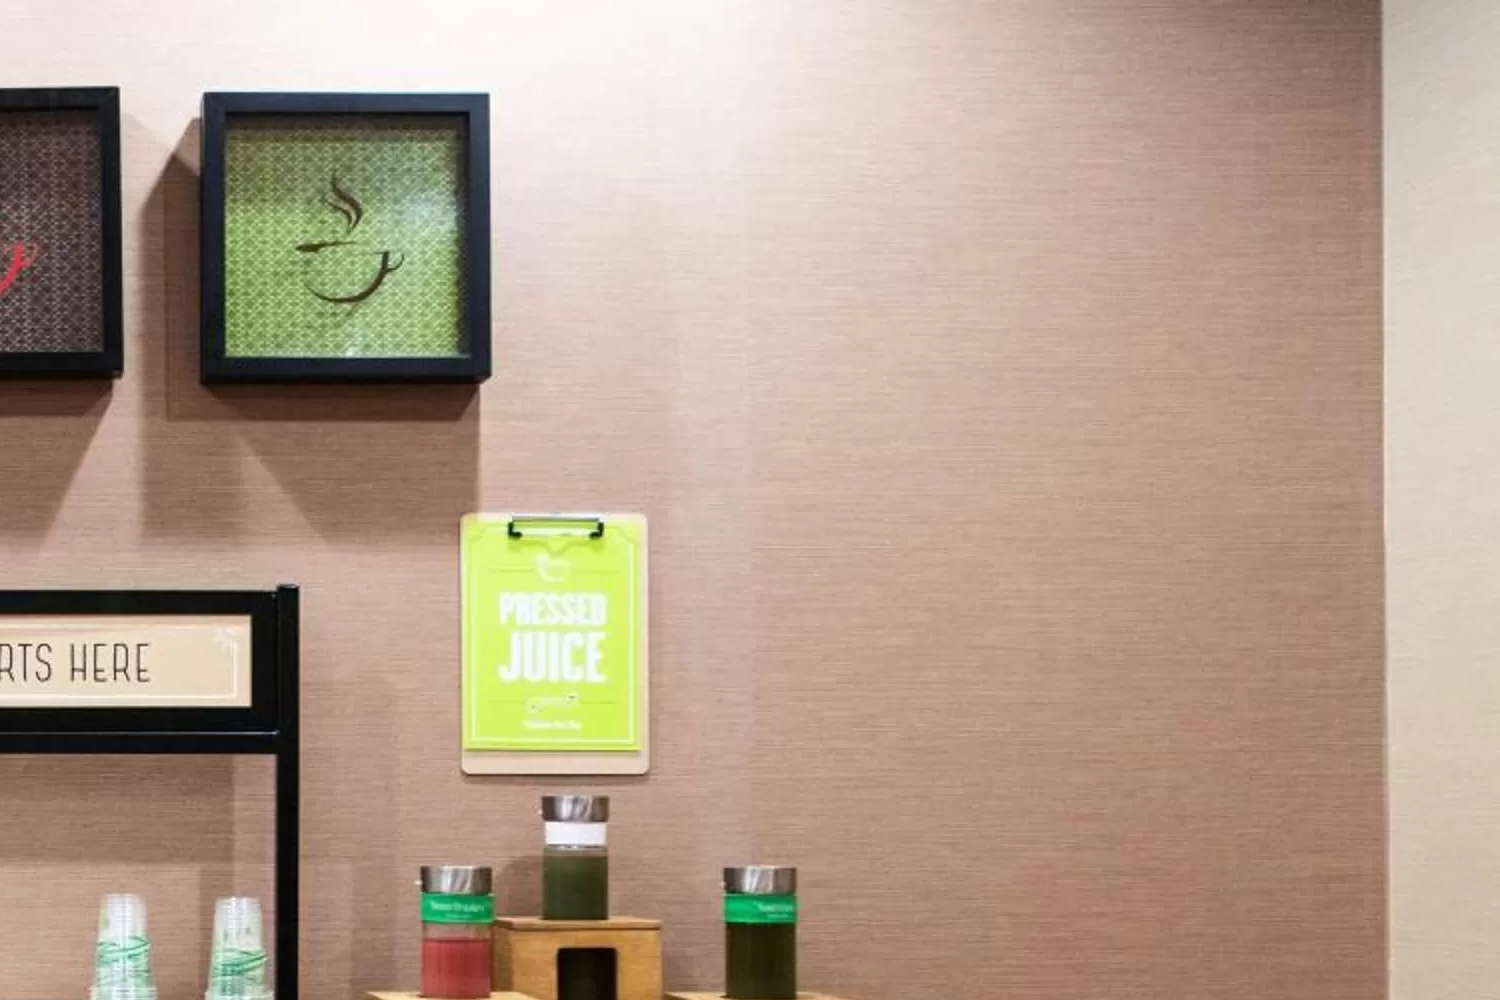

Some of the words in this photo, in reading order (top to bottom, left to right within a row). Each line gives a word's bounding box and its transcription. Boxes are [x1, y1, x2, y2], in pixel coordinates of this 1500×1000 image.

[498, 591, 607, 625] PRESSED
[70, 643, 151, 682] HERE
[497, 631, 608, 683] JUICE
